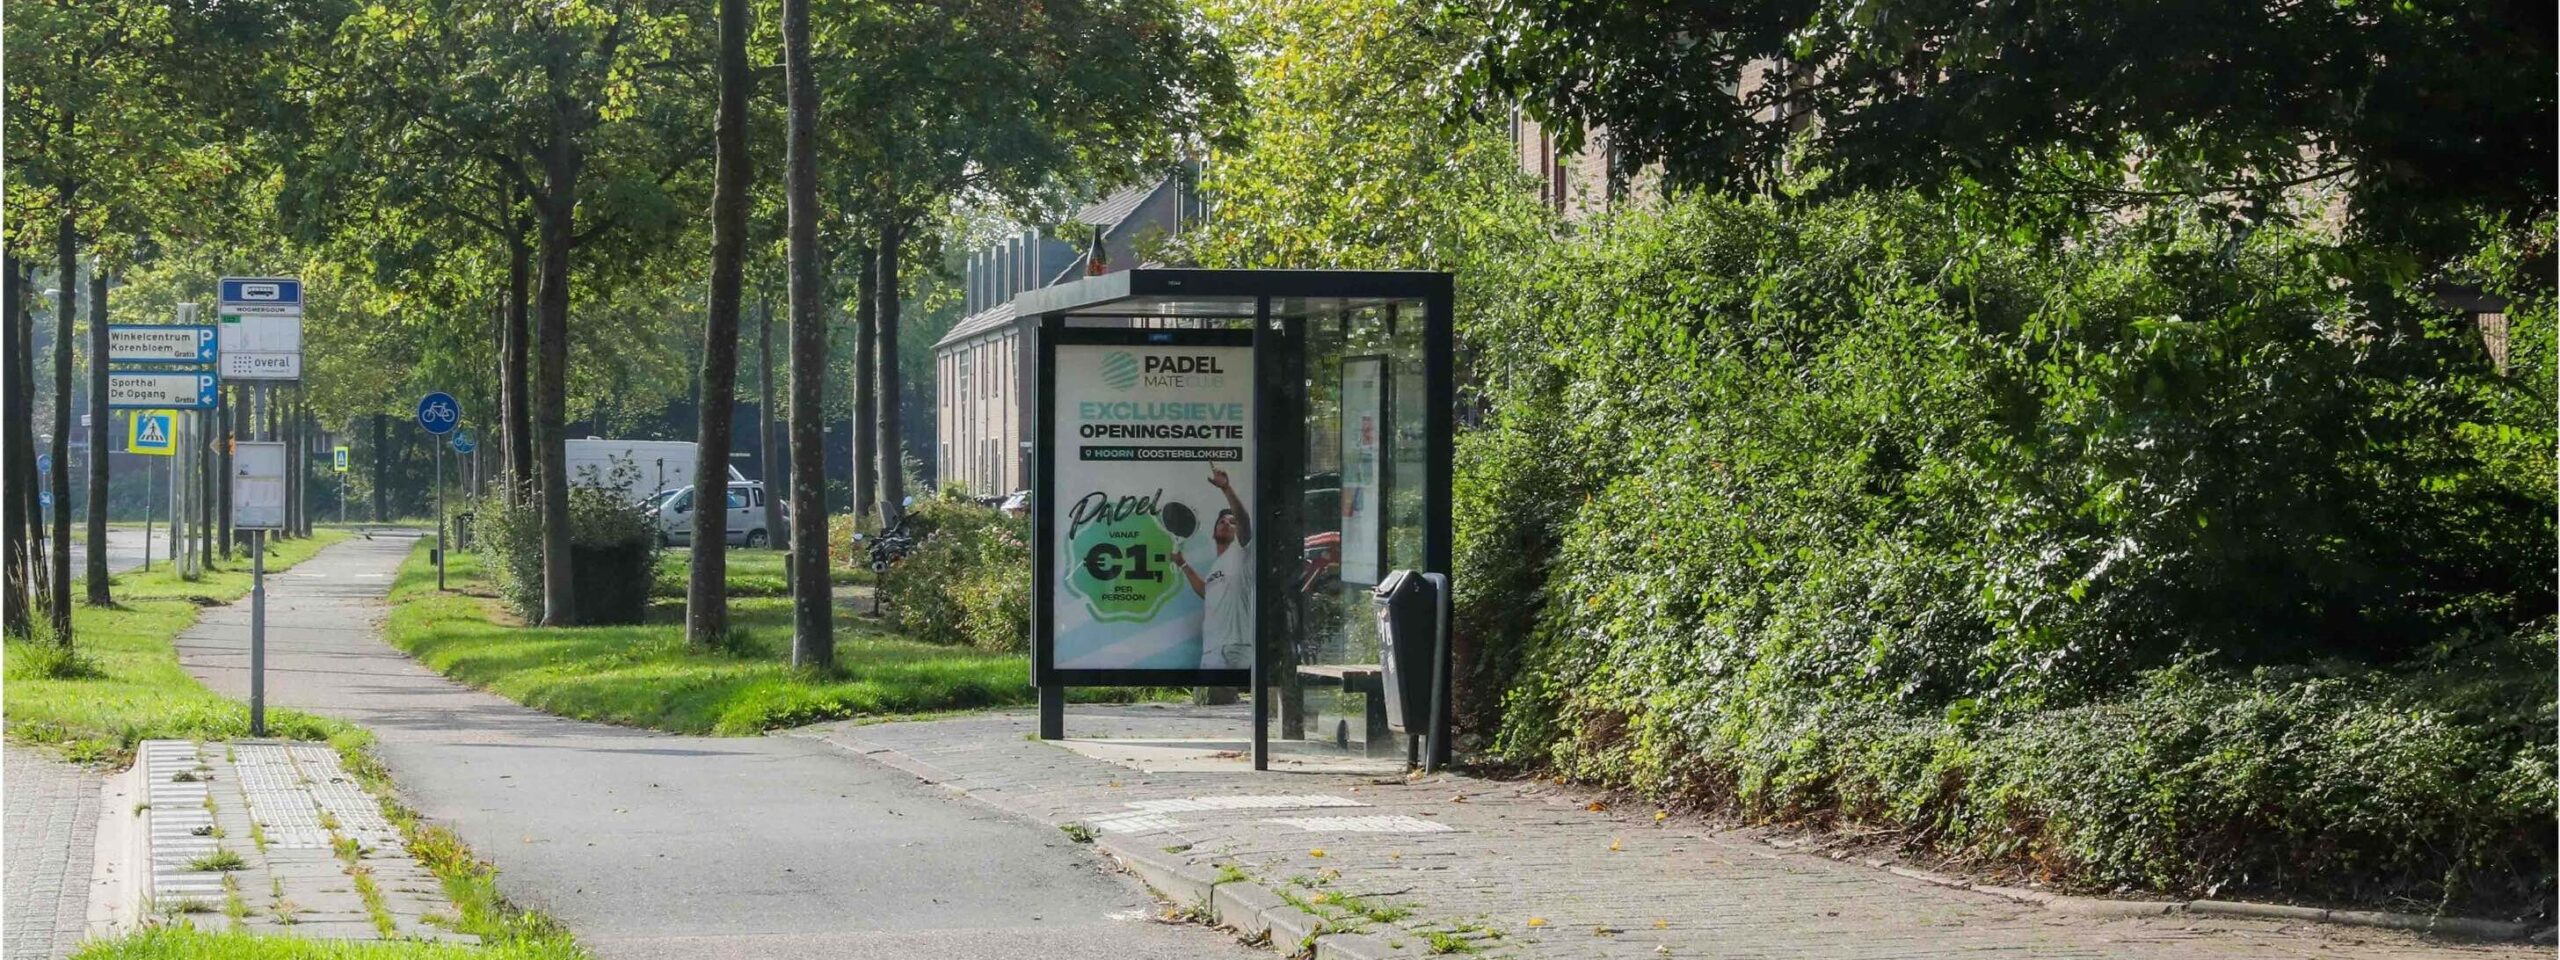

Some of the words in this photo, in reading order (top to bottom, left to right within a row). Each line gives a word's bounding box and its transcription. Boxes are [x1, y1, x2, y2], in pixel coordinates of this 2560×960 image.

[111, 333, 191, 341] Winkelcentrum
[200, 329, 214, 347] P
[111, 344, 174, 352] Korenbloem
[254, 356, 291, 368] overal
[1144, 356, 1223, 374] PADEL
[111, 379, 156, 388] Sporthal
[200, 376, 214, 393] P
[111, 390, 125, 398] De
[127, 390, 166, 399] Opgang
[1079, 402, 1243, 420] EXCLUSIEVE
[1079, 424, 1243, 439] OPENINGSACTIE
[1095, 449, 1134, 458] HOORN
[1137, 449, 1238, 459] (OOSTERBLOKKER)
[1109, 531, 1140, 539] VANAF
